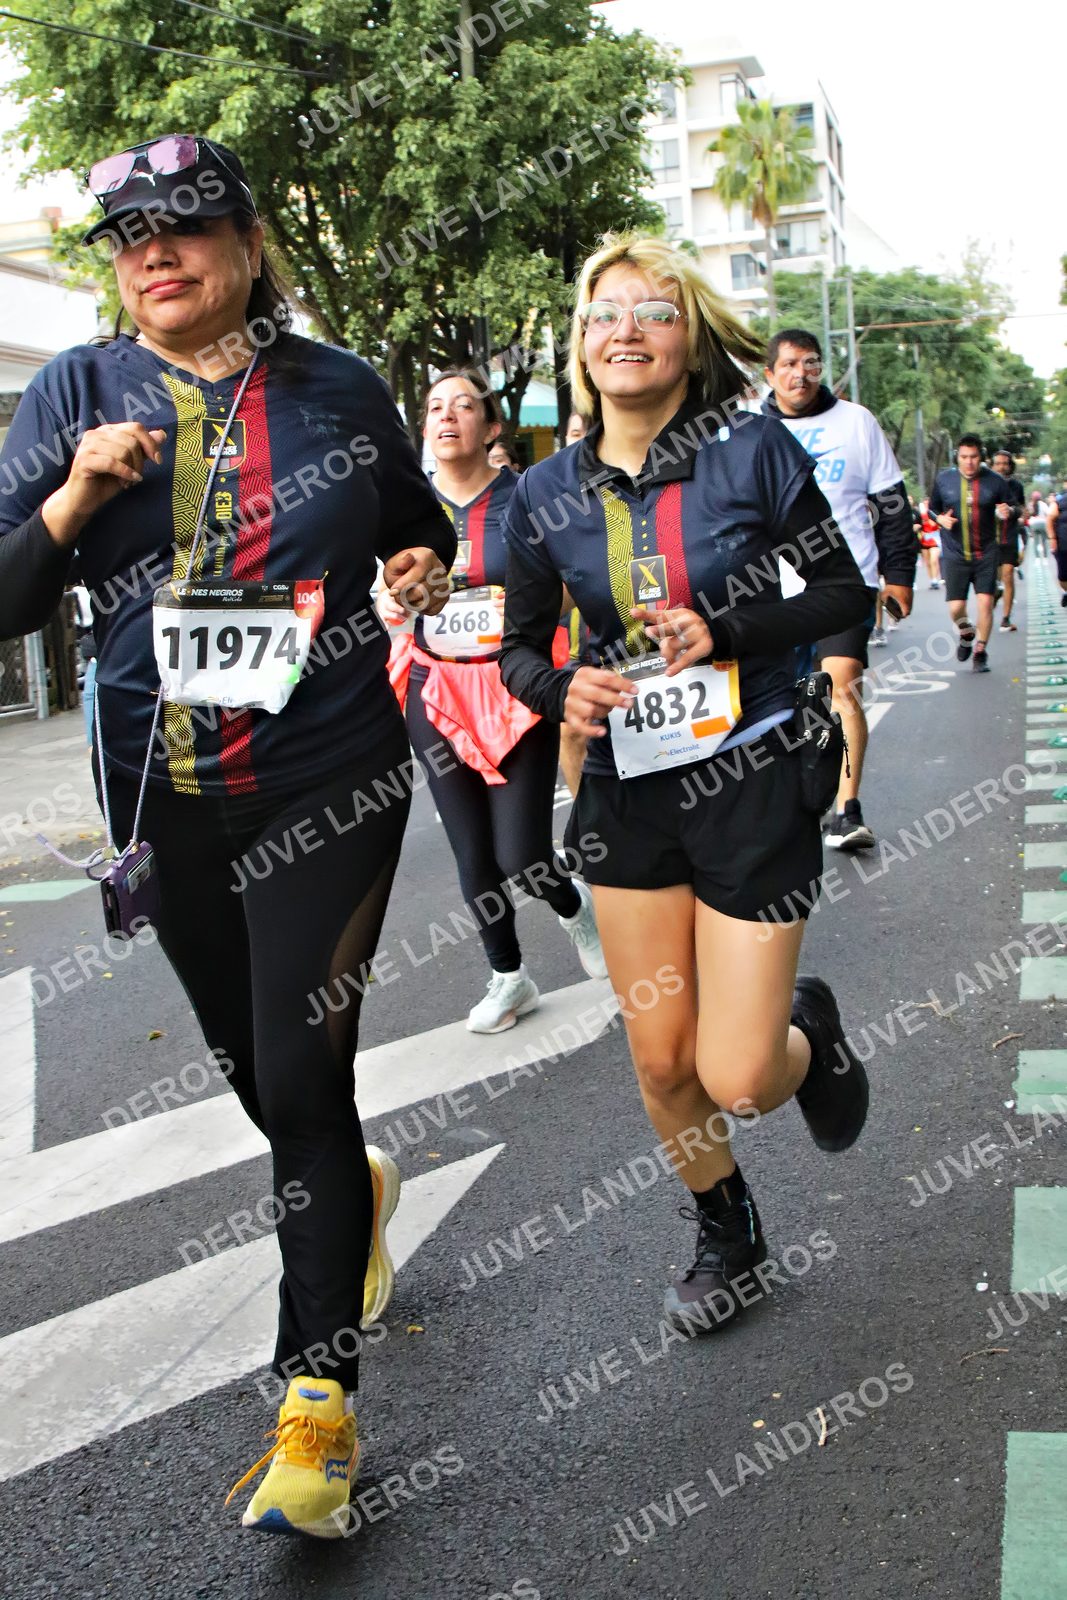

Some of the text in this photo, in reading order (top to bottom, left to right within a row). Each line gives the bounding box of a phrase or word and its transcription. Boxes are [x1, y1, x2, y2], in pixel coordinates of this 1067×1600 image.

[209, 589, 244, 597] NEGROS
[435, 610, 490, 635] 2668
[162, 626, 300, 670] 11974
[624, 681, 710, 733] 4832
[660, 731, 682, 741] KUKIS
